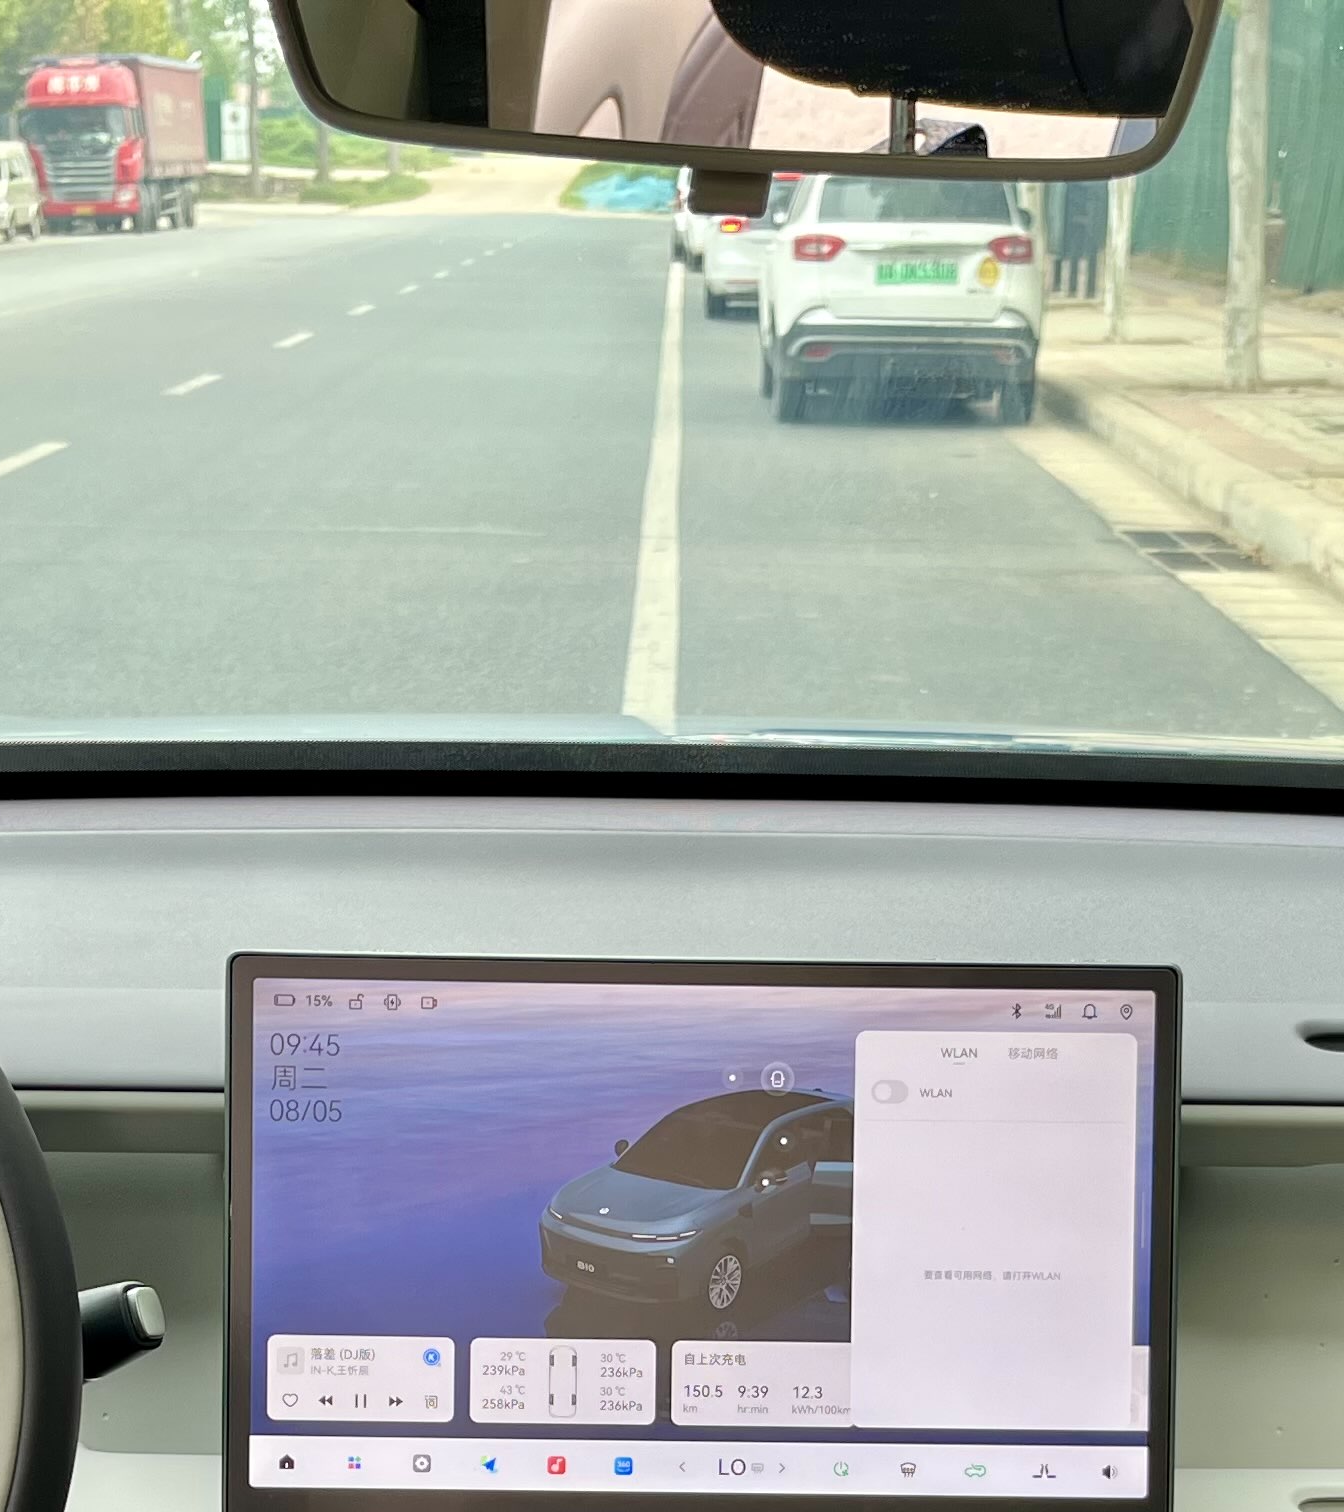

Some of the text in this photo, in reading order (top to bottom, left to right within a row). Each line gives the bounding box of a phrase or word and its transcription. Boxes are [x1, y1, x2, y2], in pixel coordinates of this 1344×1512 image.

[306, 994, 333, 1007] 15%
[270, 1033, 341, 1057] 09:45
[941, 1047, 978, 1059] WLAN
[1008, 1047, 1059, 1060] 移动网络
[272, 1065, 328, 1091] 周二
[920, 1088, 953, 1098] WLAN
[270, 1099, 342, 1123] 08/05
[684, 1353, 747, 1366] 自上次充电
[482, 1365, 526, 1376] 239kPa
[600, 1367, 643, 1378] 236kPa
[683, 1384, 823, 1400] 150.5 9:39 12.3
[482, 1398, 525, 1410] 258kPa
[599, 1400, 643, 1411] 236kPa
[682, 1403, 698, 1413] km
[718, 1458, 746, 1476] LO
